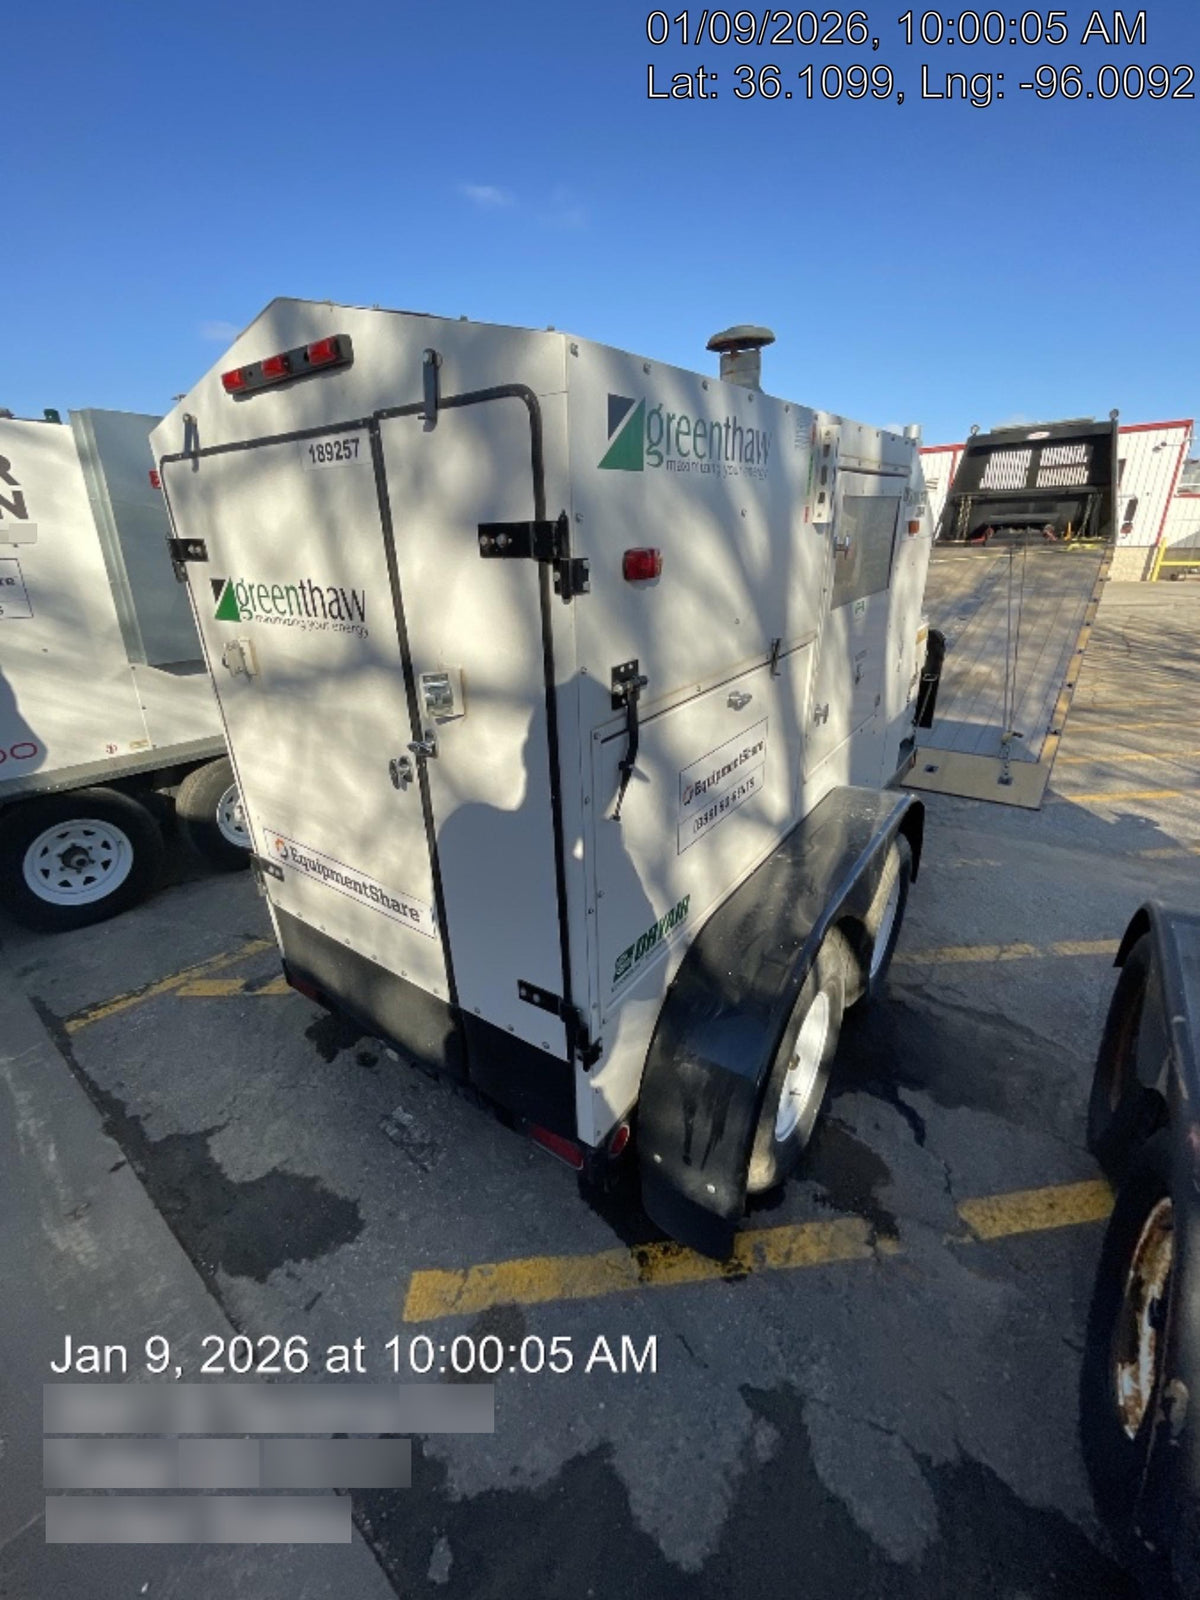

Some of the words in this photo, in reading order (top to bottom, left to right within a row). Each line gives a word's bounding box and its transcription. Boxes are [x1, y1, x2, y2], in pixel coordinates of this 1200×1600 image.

[309, 438, 360, 464] 189257
[646, 402, 772, 467] greenthaw
[235, 578, 366, 623] greenthaw
[288, 845, 421, 923] EquipmentShare
